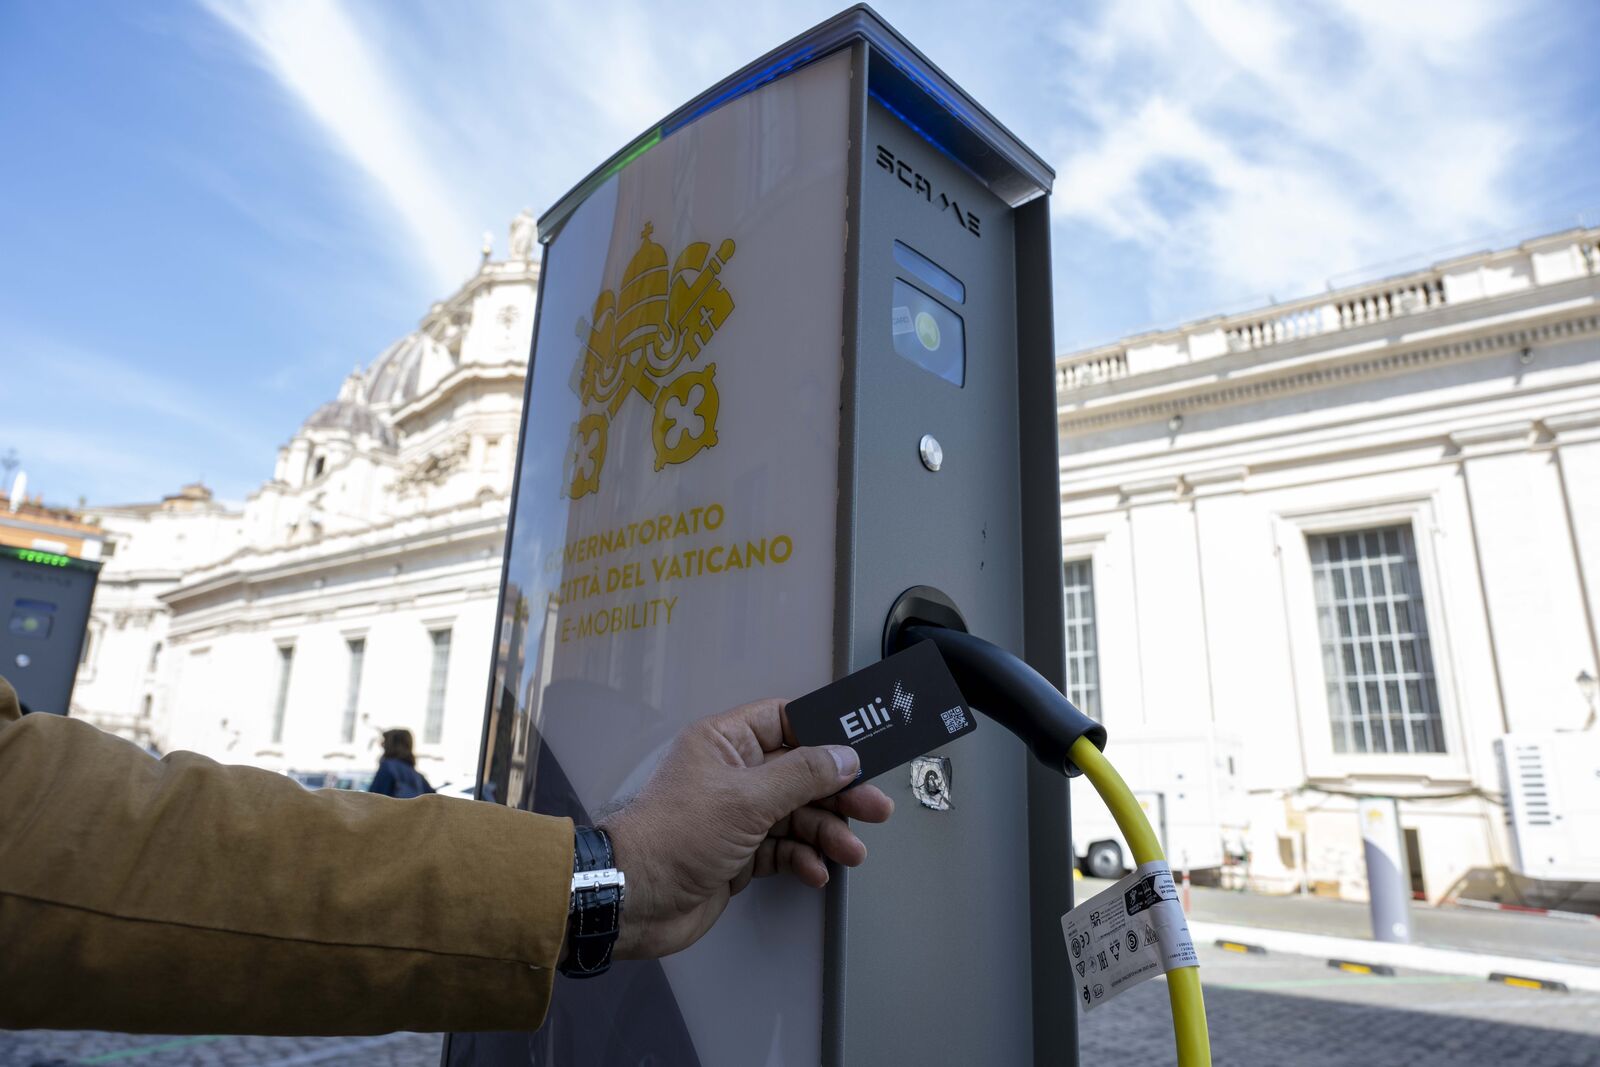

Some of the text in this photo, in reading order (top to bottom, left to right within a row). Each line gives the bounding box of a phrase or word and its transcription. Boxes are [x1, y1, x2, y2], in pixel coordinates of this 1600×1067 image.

[606, 561, 645, 594] DEL
[653, 534, 793, 582] VATICANO
[560, 596, 679, 643] E-MOBILITY
[839, 696, 890, 739] Elli
